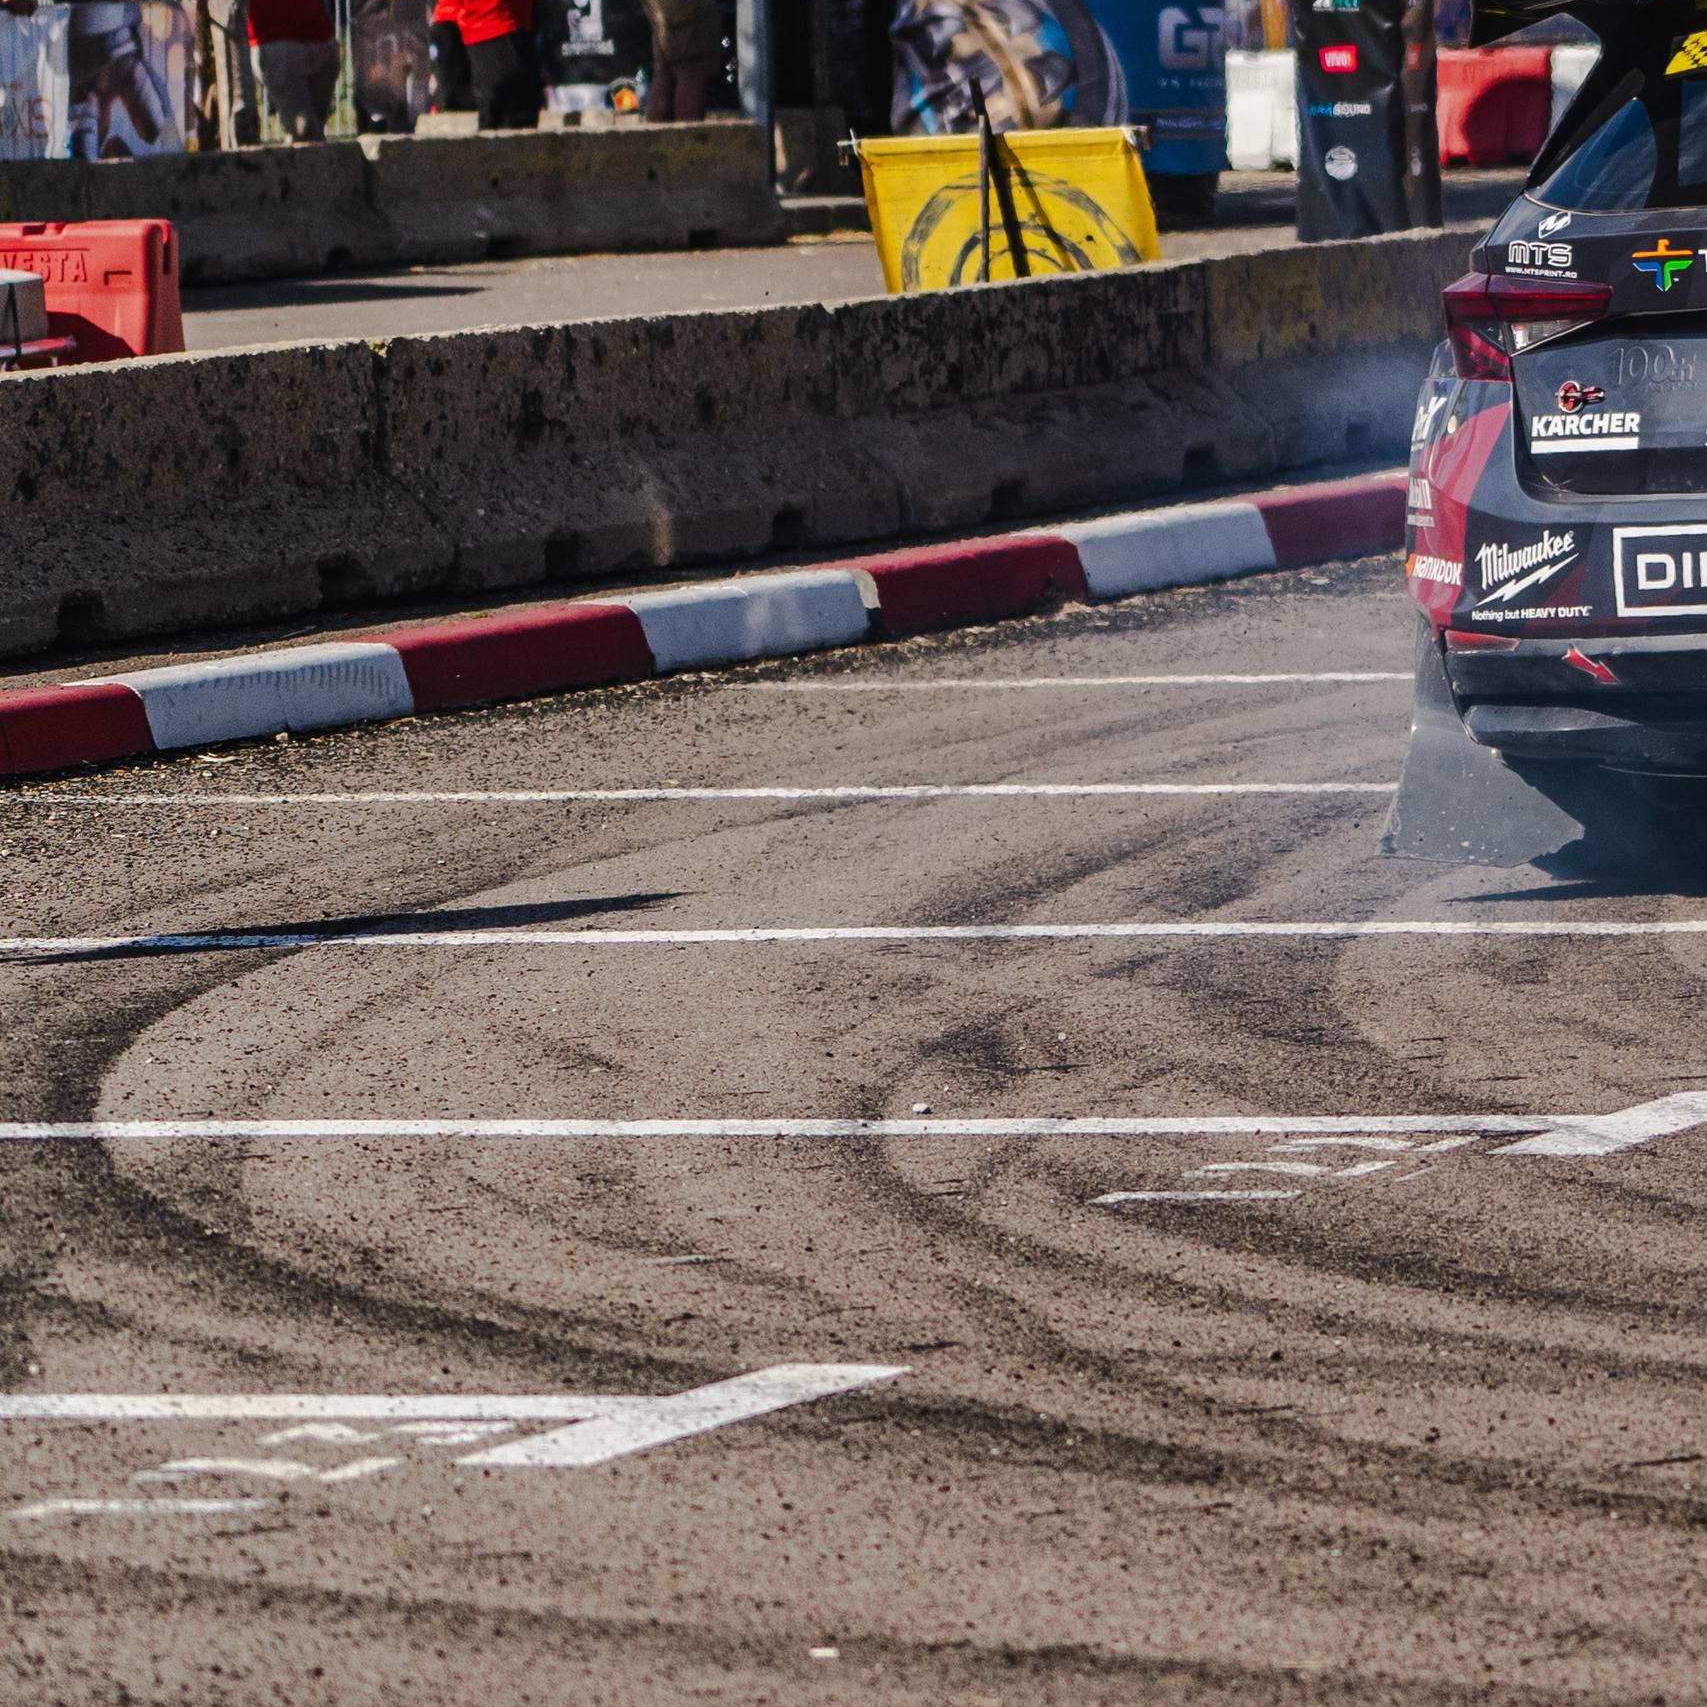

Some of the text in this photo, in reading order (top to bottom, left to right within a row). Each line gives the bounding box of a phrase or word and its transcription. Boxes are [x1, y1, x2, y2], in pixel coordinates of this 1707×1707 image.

[1508, 240, 1573, 267] MTS
[1471, 609, 1504, 622] Nothing
[1505, 609, 1520, 620] but
[1520, 607, 1556, 619] HEAVY
